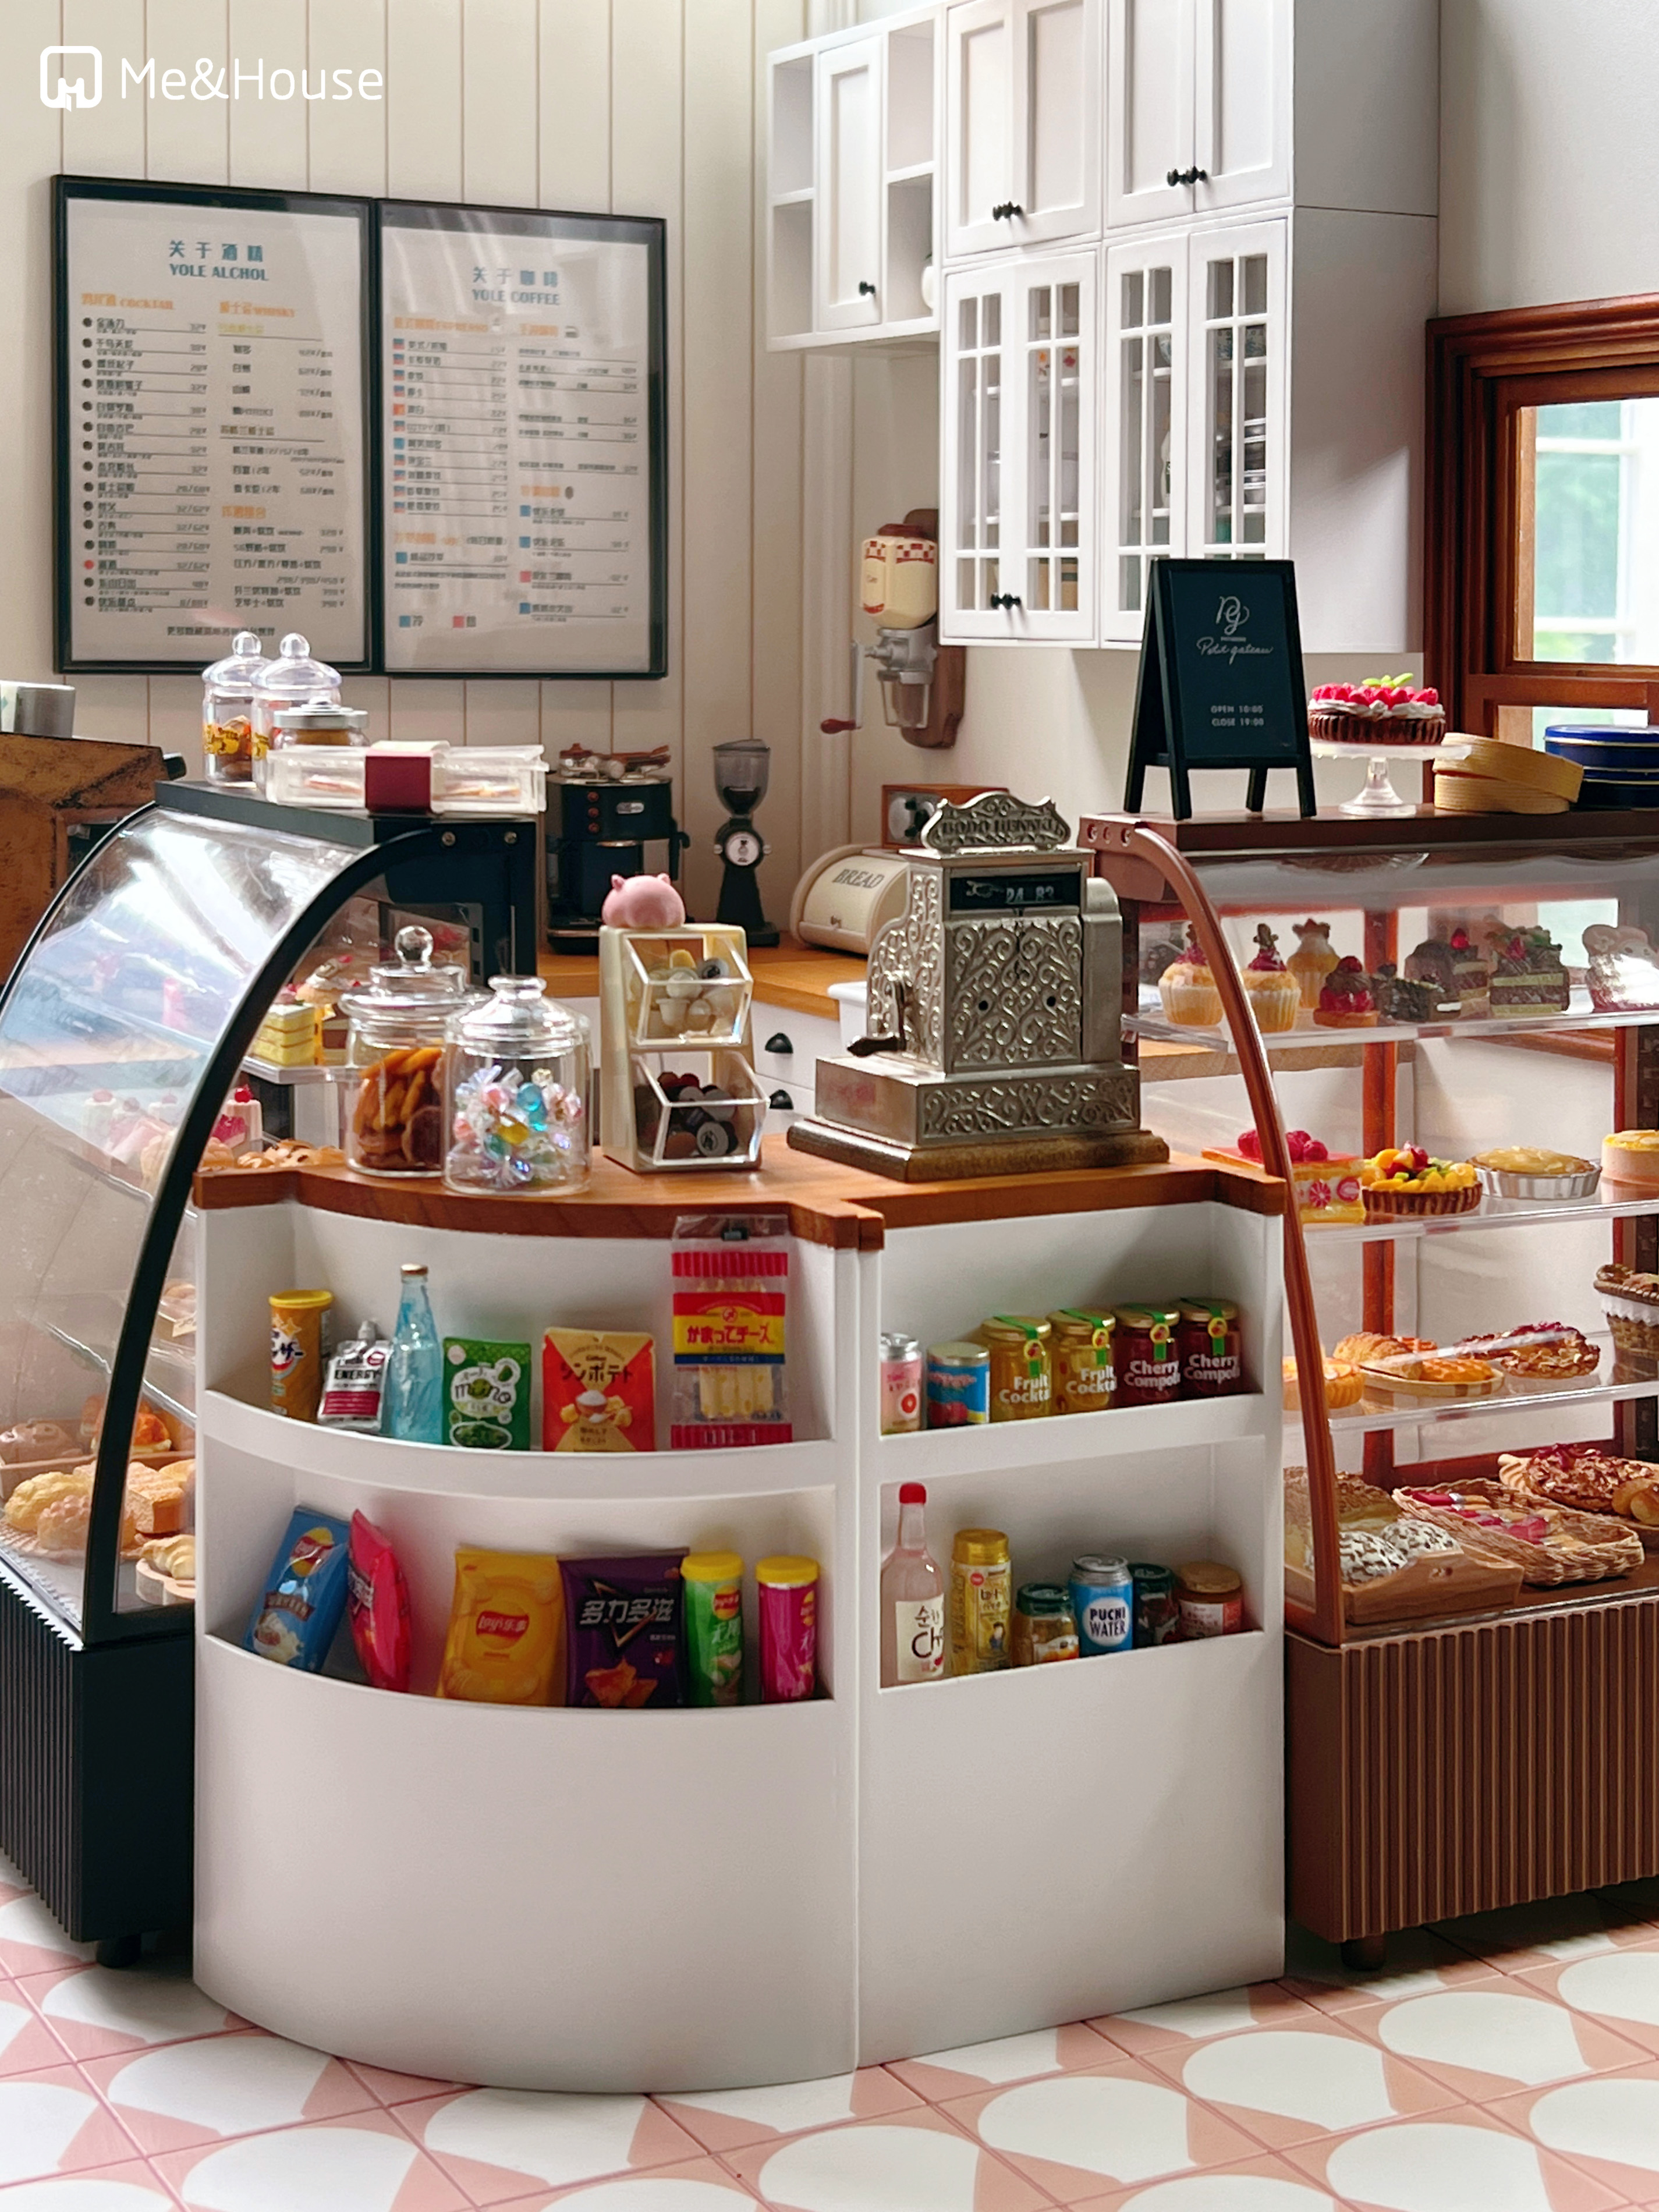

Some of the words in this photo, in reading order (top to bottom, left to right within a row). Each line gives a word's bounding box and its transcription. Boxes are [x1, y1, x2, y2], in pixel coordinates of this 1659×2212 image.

[169, 263, 206, 277] YOLE
[212, 266, 269, 281] ALCHOL
[473, 289, 505, 302] YOLE
[511, 291, 559, 306] COFFEE
[832, 869, 885, 888] BREAD
[580, 1598, 675, 1625] 多力多滋
[1090, 1621, 1126, 1636] WATER
